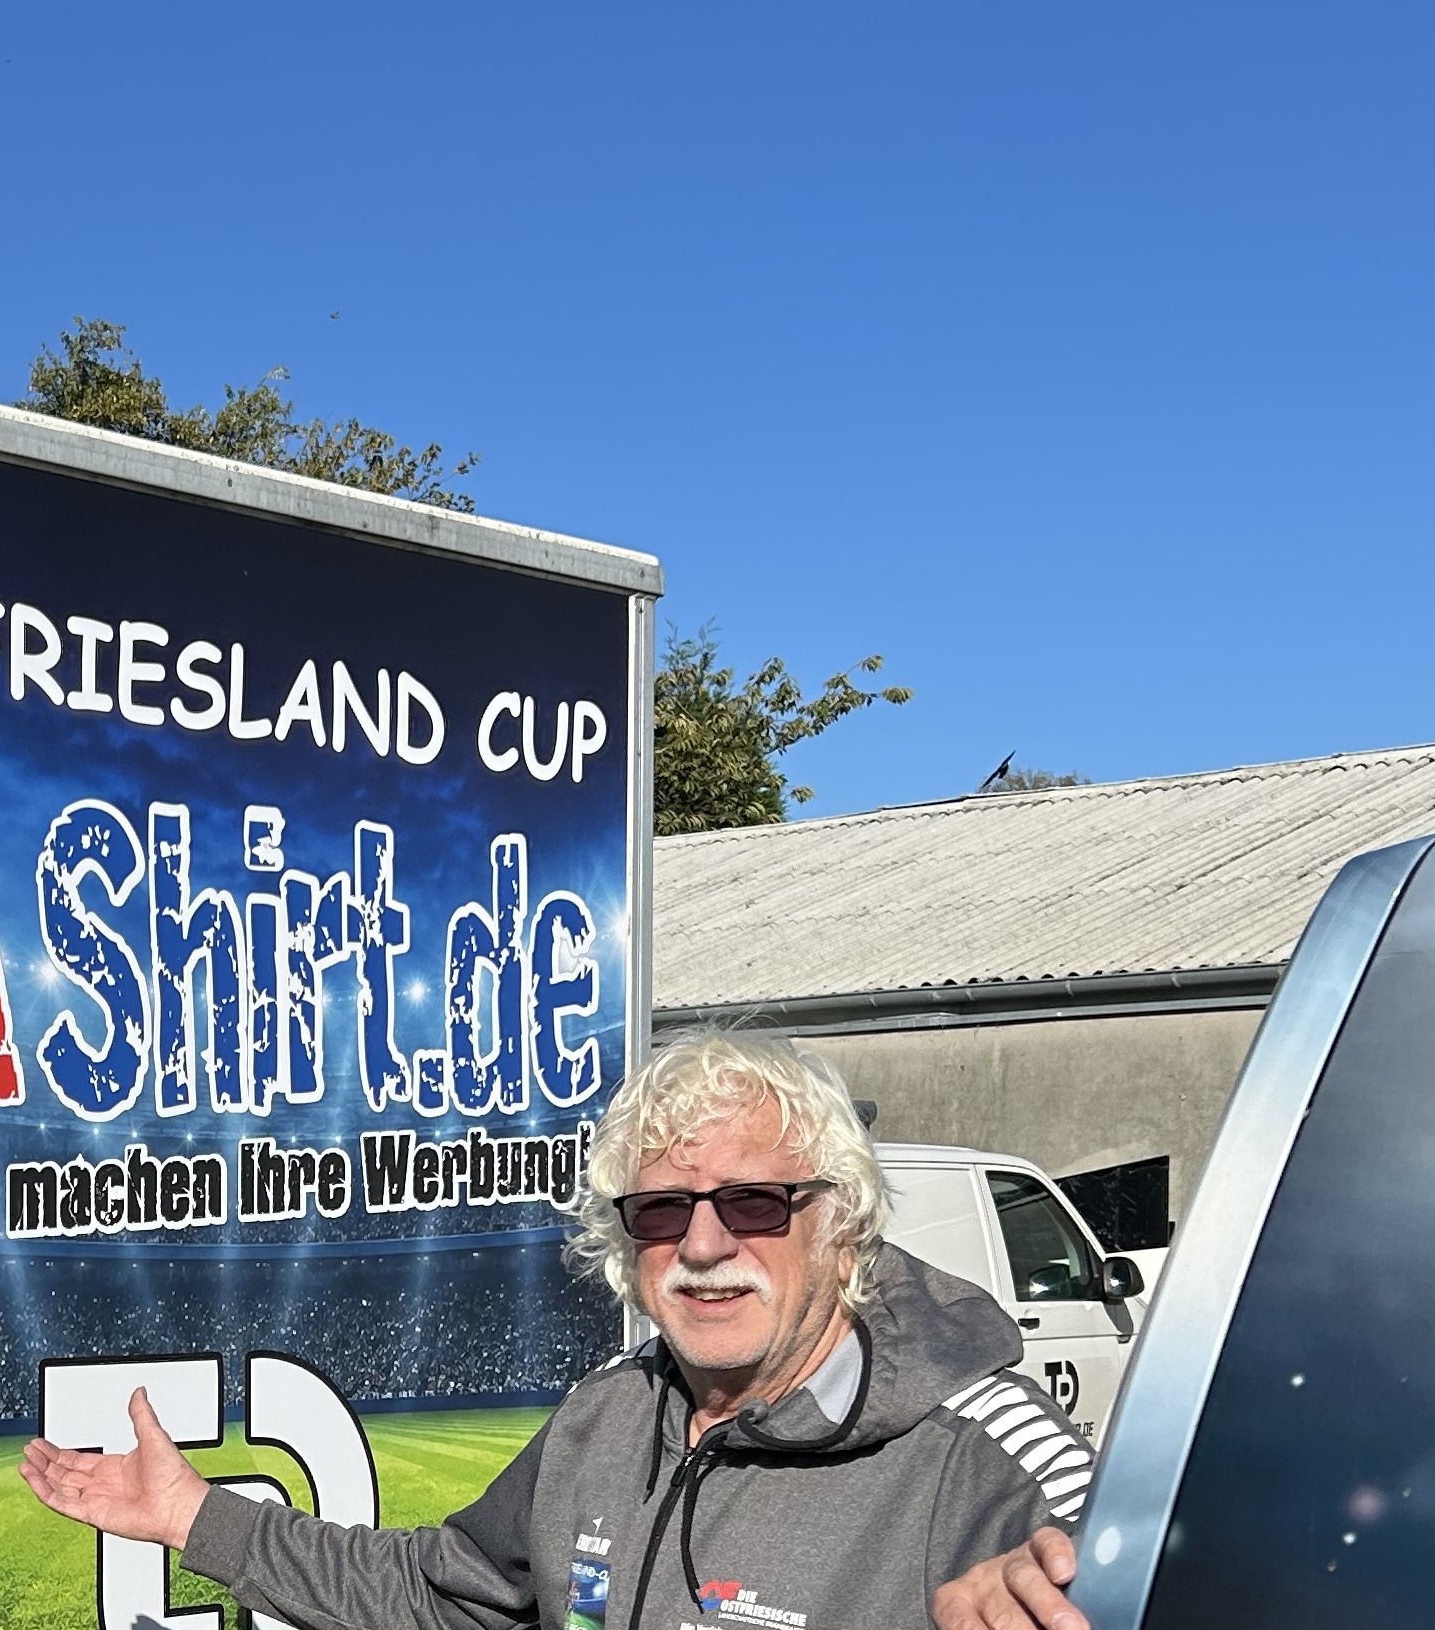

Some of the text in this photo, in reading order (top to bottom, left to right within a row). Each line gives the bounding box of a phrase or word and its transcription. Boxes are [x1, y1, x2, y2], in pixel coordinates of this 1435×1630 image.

[478, 692, 608, 784] CUP
[8, 1149, 224, 1236] machen
[240, 1141, 348, 1222] Ihre
[720, 1599, 807, 1627] OSTFRIESISCHE
[736, 1588, 759, 1604] DIE
